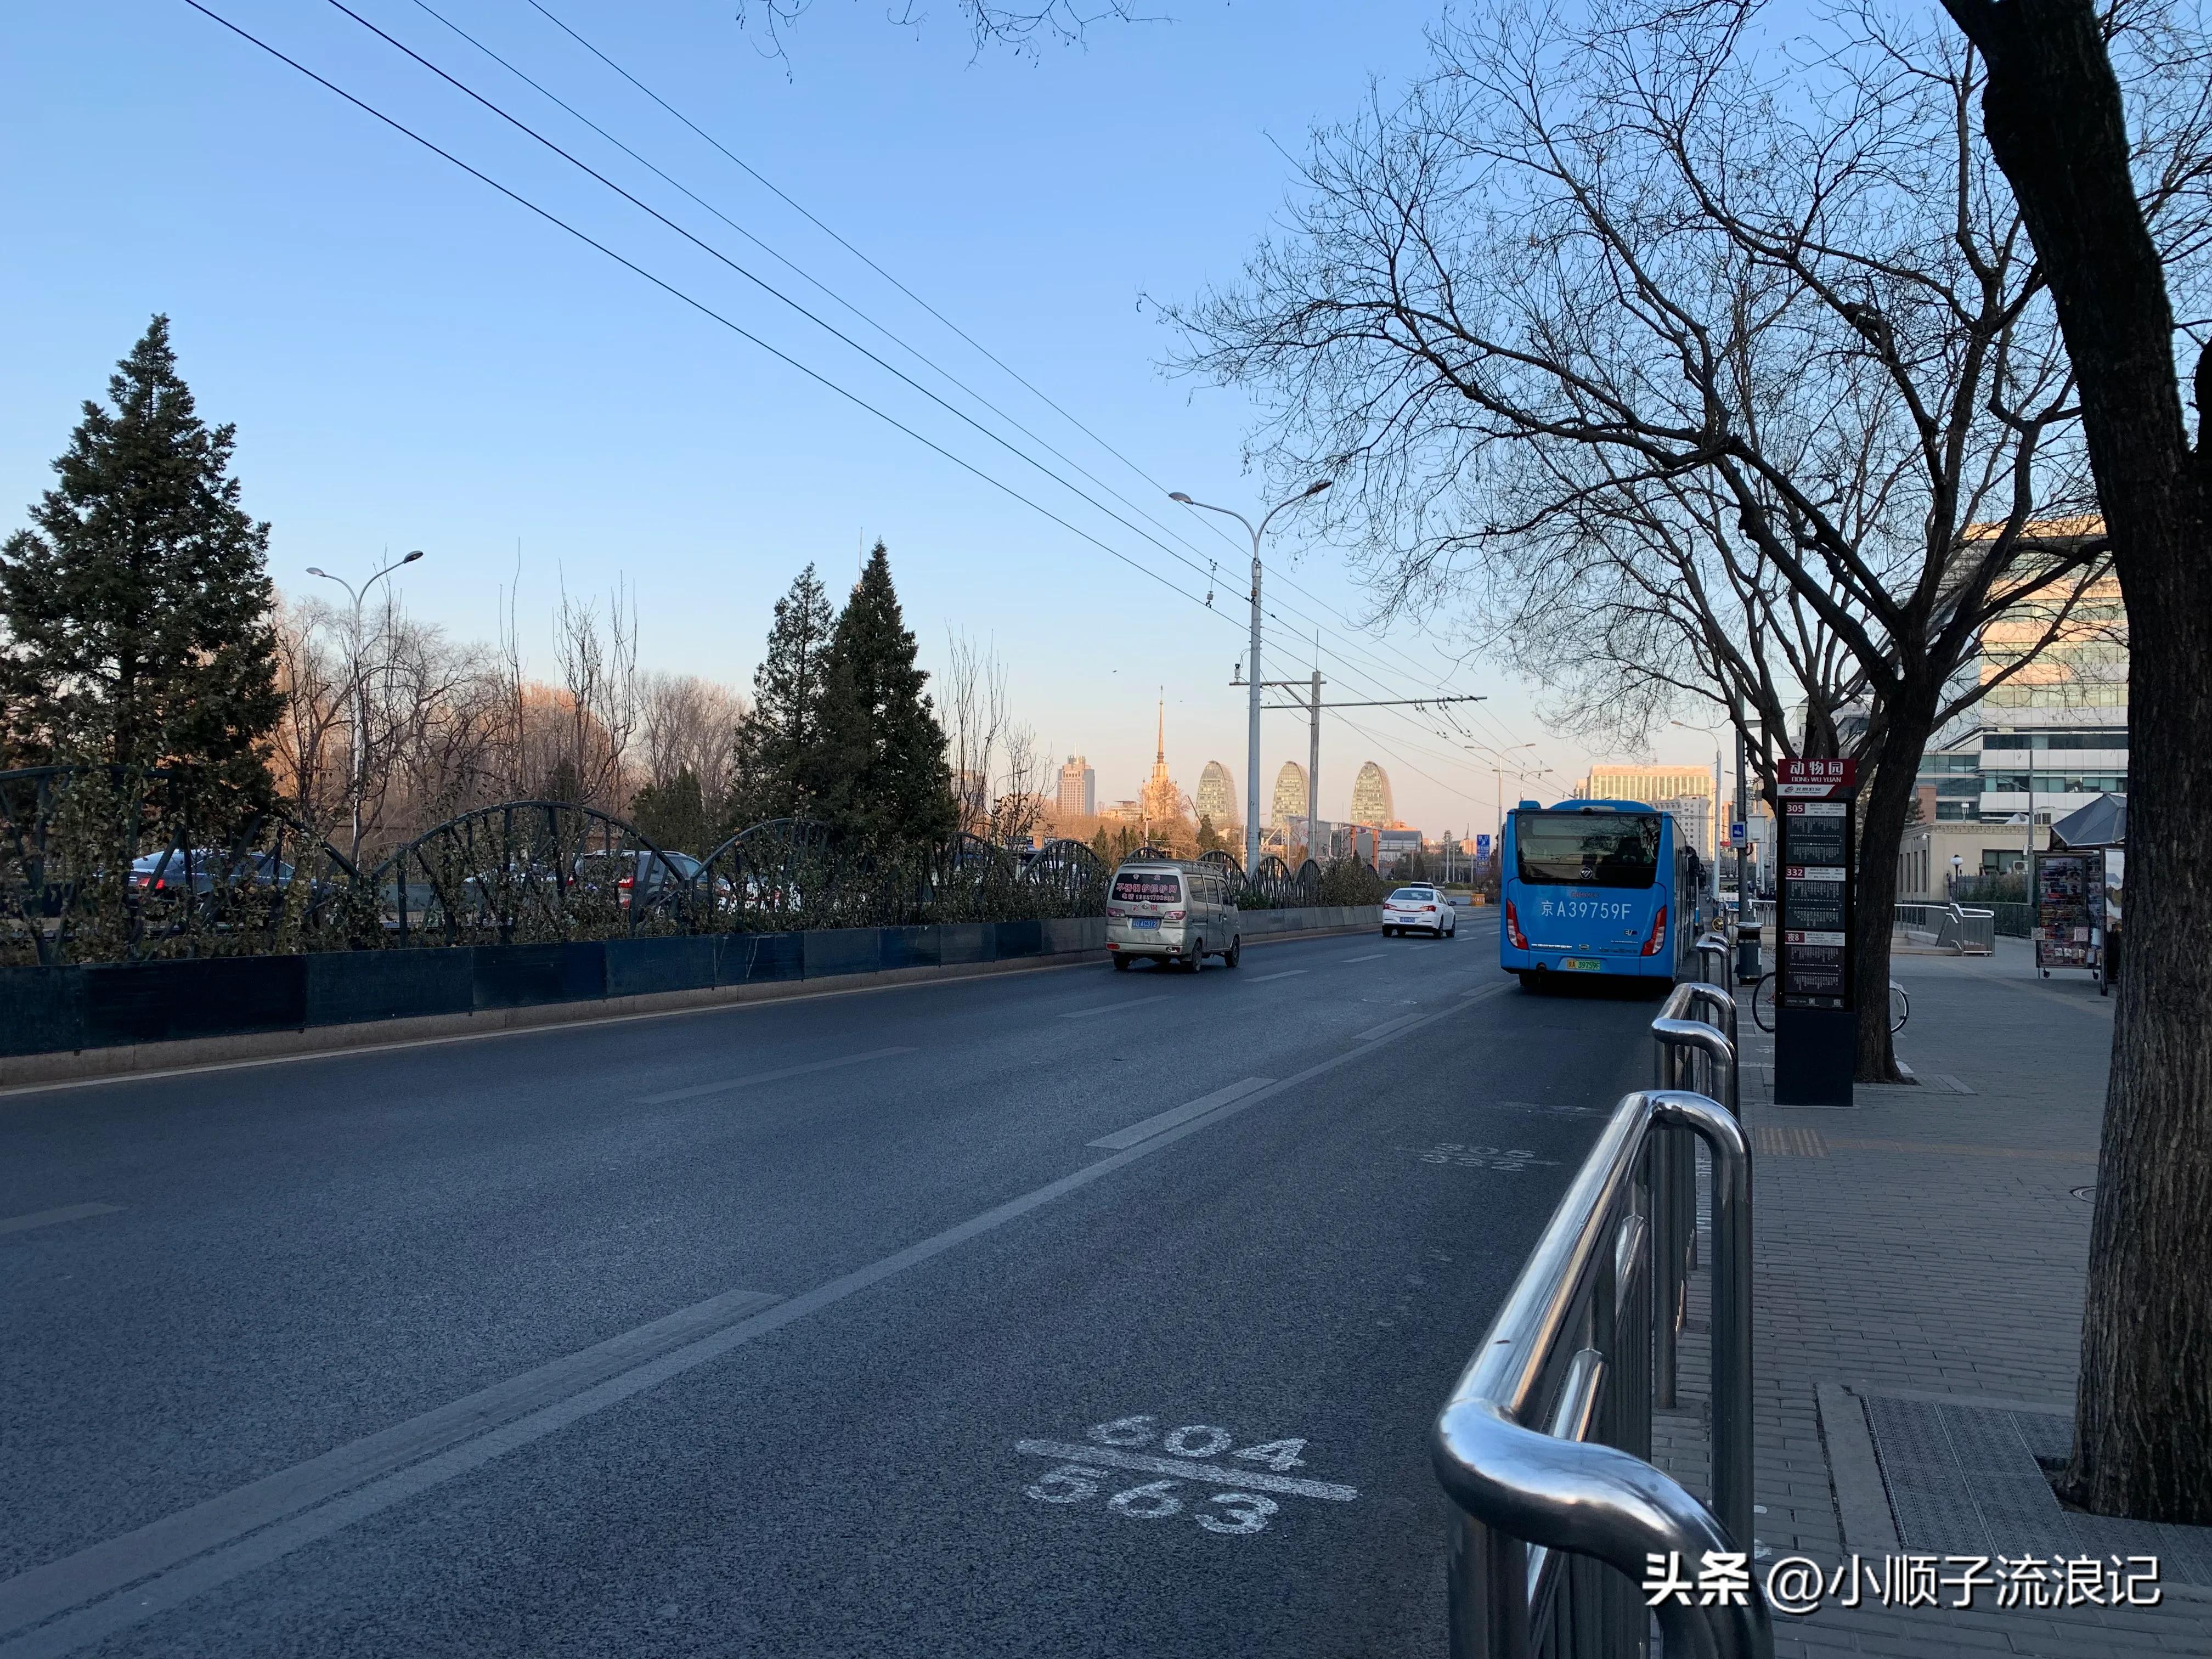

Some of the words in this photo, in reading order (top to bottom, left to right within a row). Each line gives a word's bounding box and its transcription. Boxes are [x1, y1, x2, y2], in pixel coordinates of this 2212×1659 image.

[1790, 761, 1843, 775] 动物园
[1542, 900, 1632, 919] 京A39759F
[1787, 933, 1799, 942] 夜8
[1087, 1415, 1307, 1472] 604
